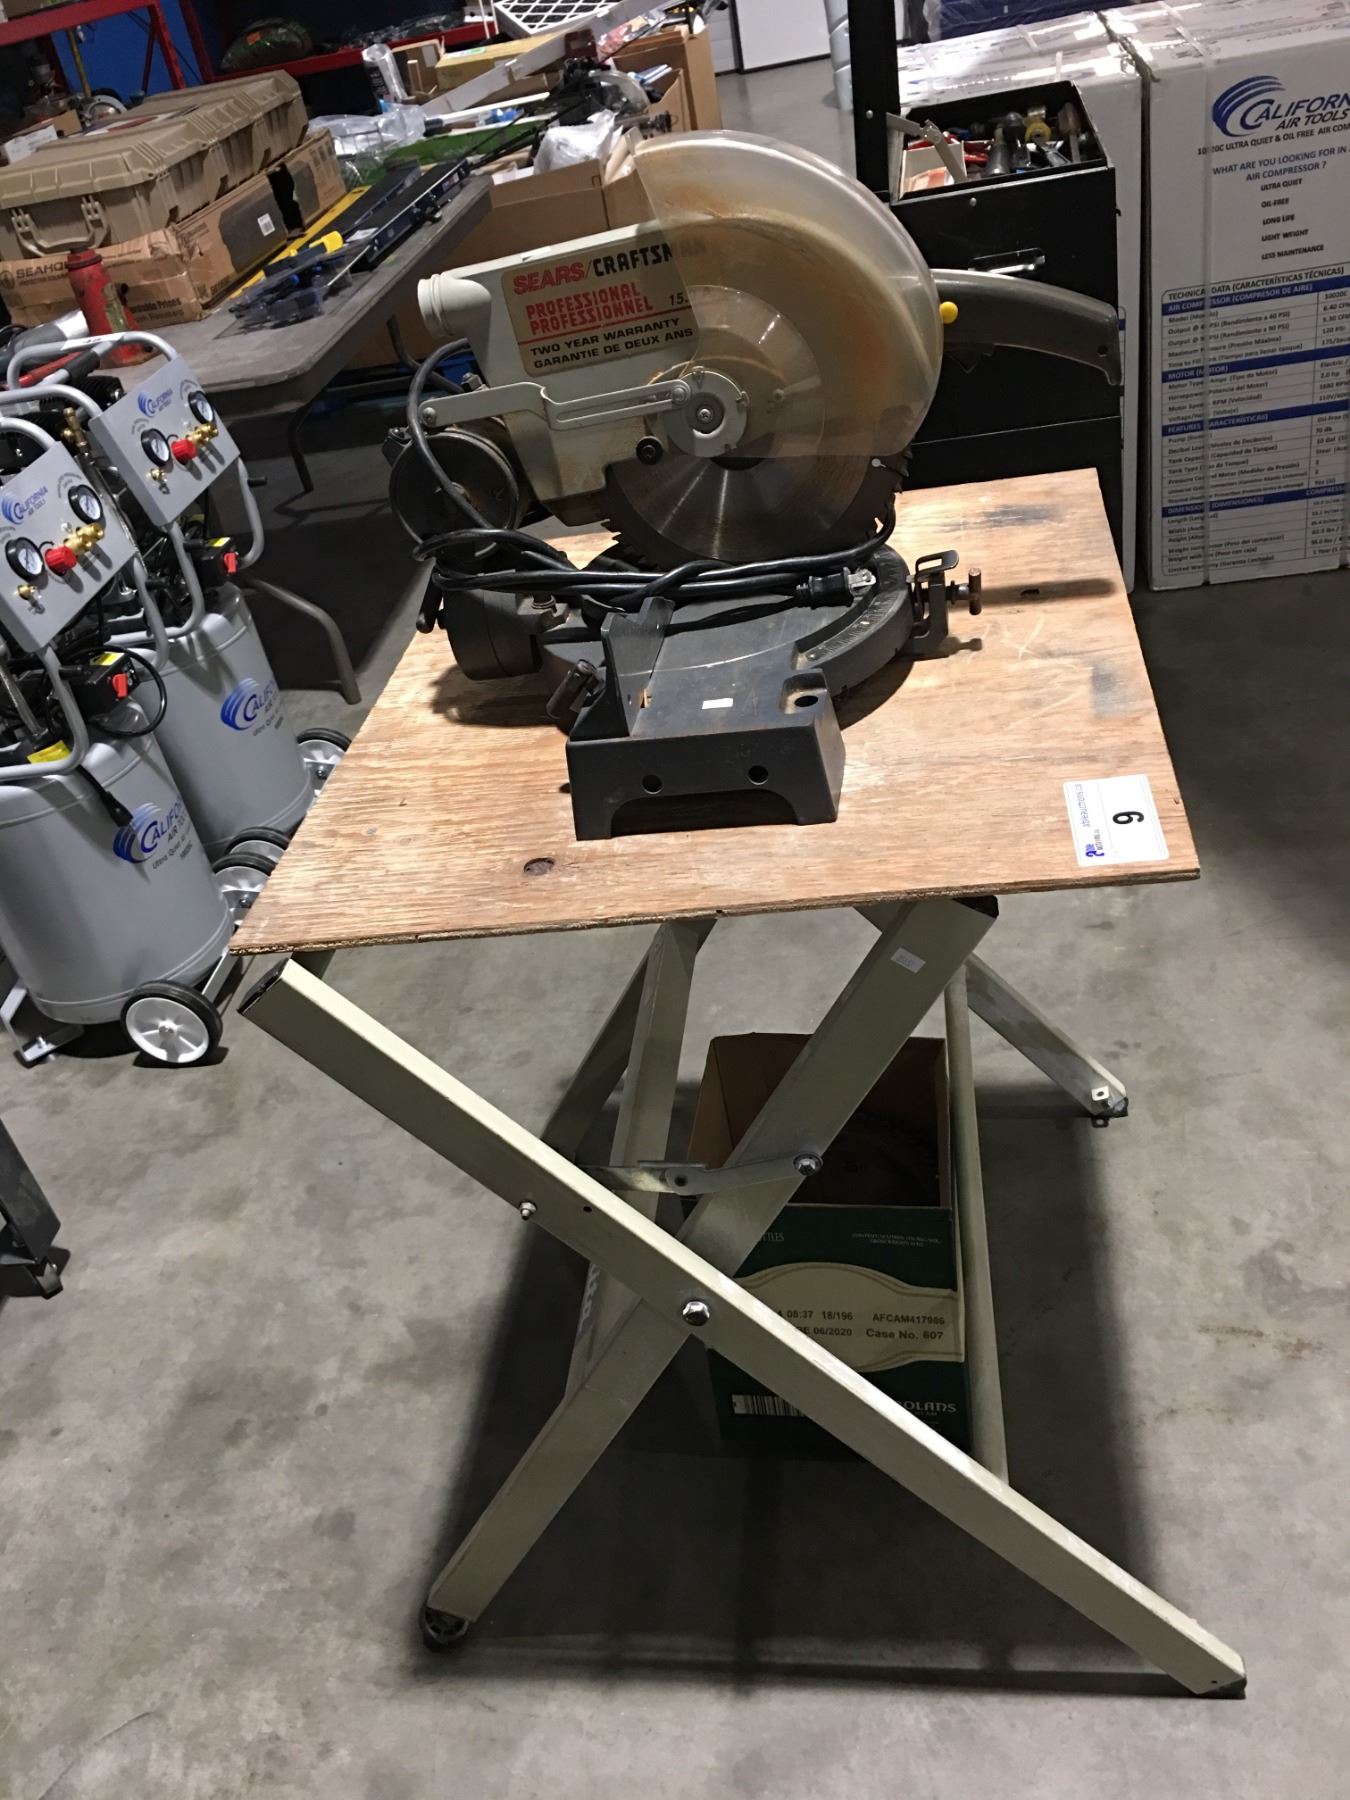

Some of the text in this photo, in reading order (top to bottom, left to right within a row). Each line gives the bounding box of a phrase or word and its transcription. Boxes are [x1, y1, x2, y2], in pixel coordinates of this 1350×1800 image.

[1275, 108, 1350, 131] AIR TOOLS
[1225, 140, 1249, 151] ULTRA
[1250, 136, 1274, 147] QUIET
[1275, 134, 1281, 142] &
[1283, 132, 1294, 141] OIL
[1296, 129, 1314, 138] FREE
[1317, 126, 1331, 135] AIR
[1212, 145, 1347, 175] WHAT ARE YOU LOOKING FOR IN
[1246, 172, 1260, 181] AIR
[1262, 163, 1320, 179] COMPRESSOR
[1260, 178, 1303, 191] ULTRA QUIET
[1261, 197, 1290, 208] OIL-FREE
[1262, 214, 1295, 225] LONG LIFE
[1261, 229, 1309, 242] LIGHT WEIGHT
[1261, 244, 1324, 260] LESS MAINTENANCE
[16, 262, 70, 279] SEAHO
[1168, 266, 1344, 301] TECHNICA DATA (CARACTERÍSTICAS TÉCNICAS)
[526, 282, 641, 320] PROFESSIONAL
[1168, 304, 1180, 312] AIR
[1282, 286, 1292, 295] DE
[1293, 284, 1313, 294] AIRE)
[529, 295, 654, 336] PROFESSIONNEL
[530, 317, 680, 356] TWO YEAR WARRANTY
[534, 328, 694, 369] GARANTIE DE DEUX ANS
[1168, 371, 1195, 379] MOTOR
[1168, 423, 1201, 433] FEATURES
[787, 1310, 814, 1319] 08:37
[822, 1311, 853, 1320] 18/196
[814, 1328, 852, 1336] 06/2020
[866, 1328, 895, 1339] Case
[899, 1330, 919, 1340] No.
[923, 1331, 943, 1340] 607
[897, 1400, 957, 1413] OLANS
